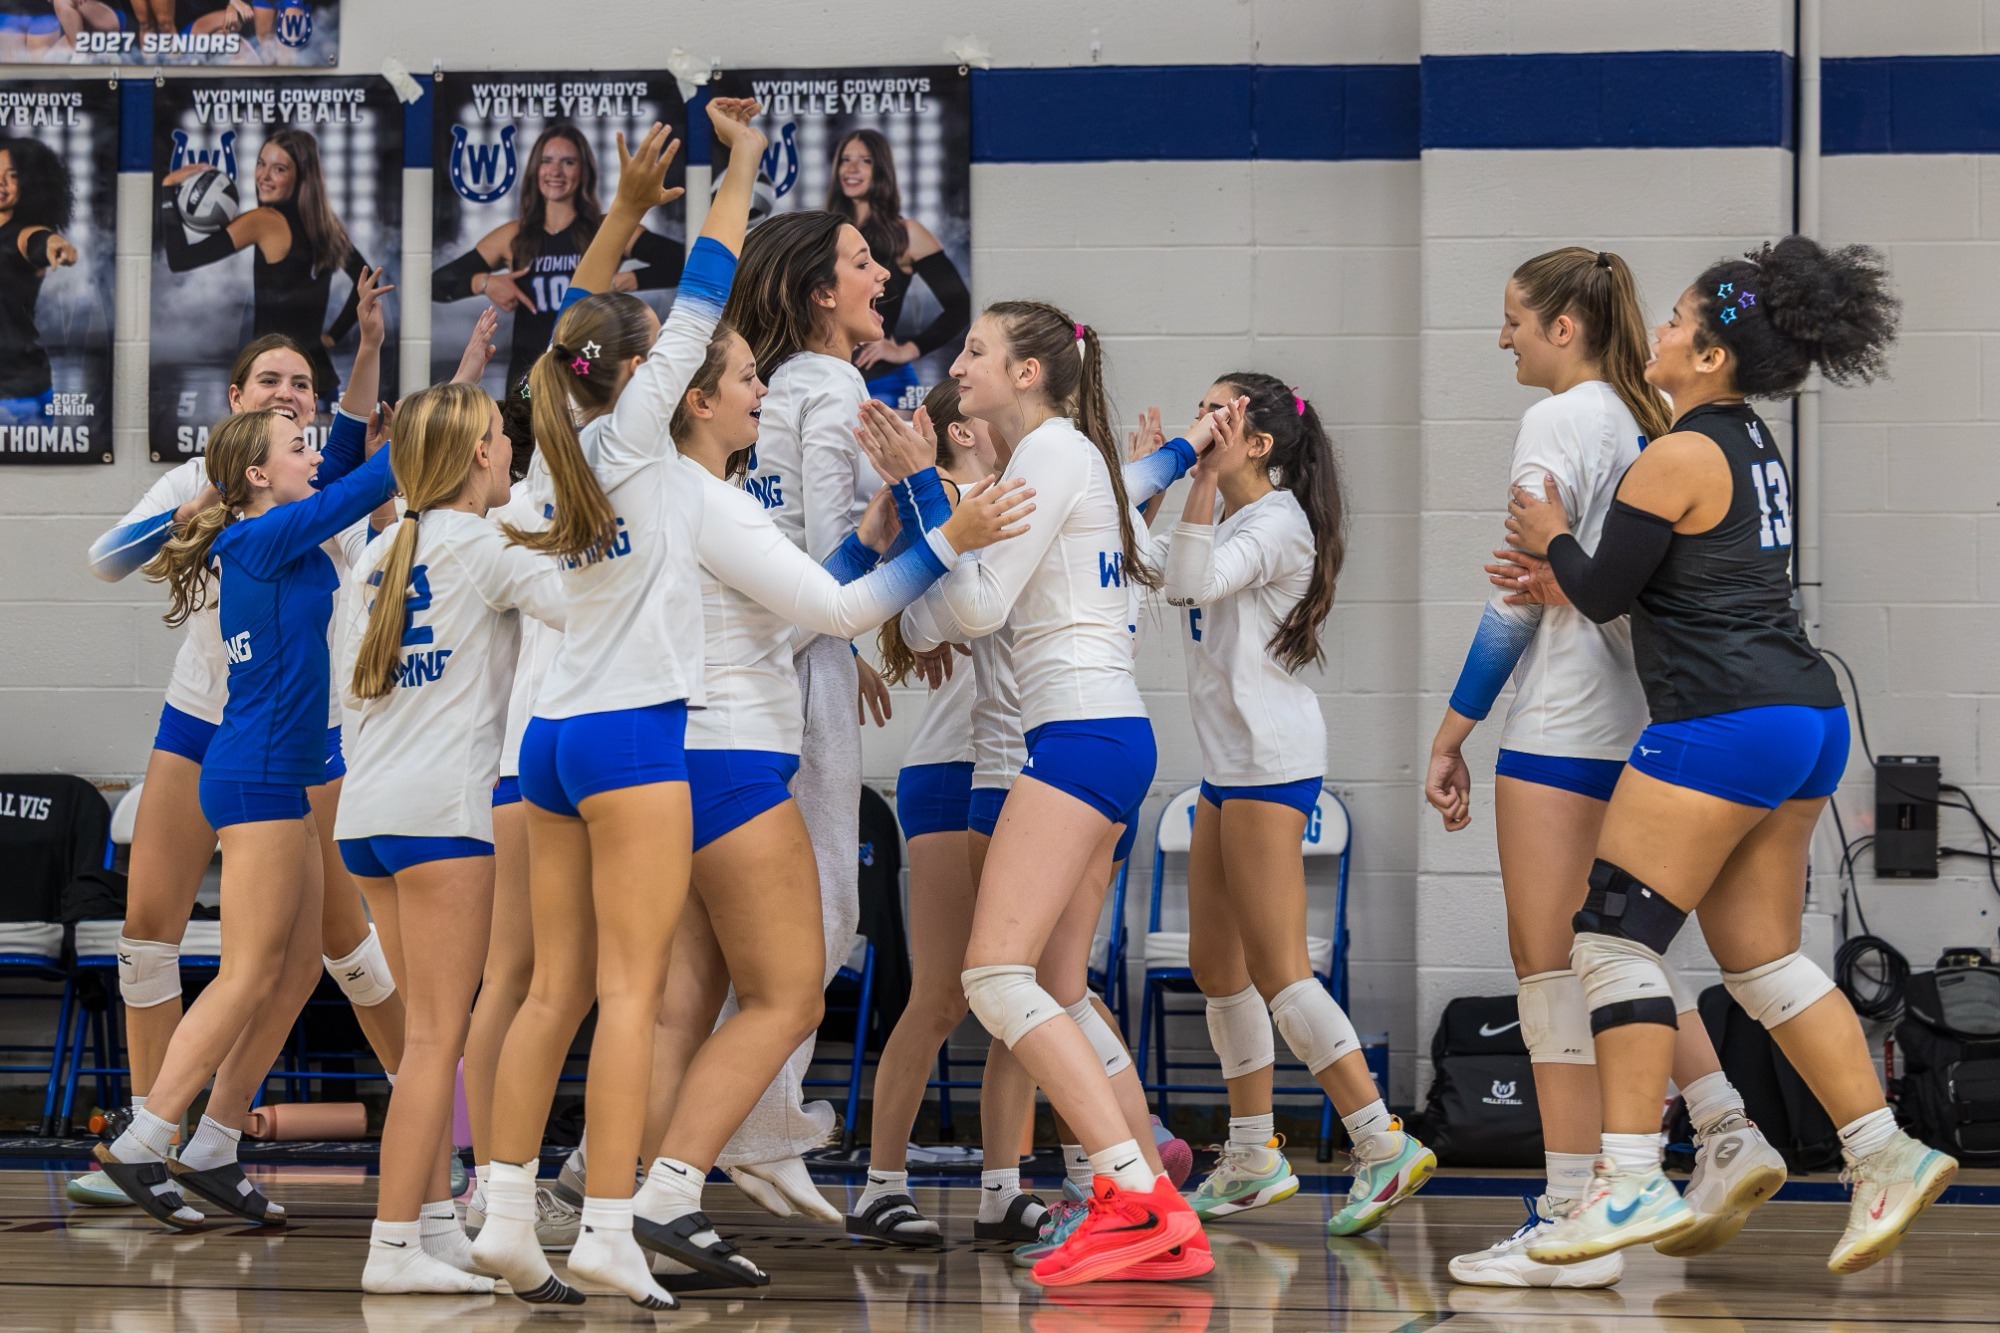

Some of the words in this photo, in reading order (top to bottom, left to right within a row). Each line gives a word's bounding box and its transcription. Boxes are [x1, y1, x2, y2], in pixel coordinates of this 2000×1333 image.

[76, 32, 136, 54] 2027
[143, 33, 241, 54] SENIORS
[192, 89, 276, 104] WYOMING
[280, 88, 366, 103] COWBOYS
[472, 82, 557, 98] WYOMING
[561, 82, 648, 97] COWBOYS
[752, 80, 838, 95] WYOMING
[843, 78, 931, 93] COWBOYS
[0, 92, 83, 107] COWBOYS
[475, 97, 646, 118] VOLLEYBALL
[755, 92, 930, 115] VOLLEYBALL
[195, 102, 364, 124] VOLLEYBALL
[467, 144, 500, 185] W
[532, 275, 571, 312] 10
[45, 404, 95, 416] SENIOR
[53, 393, 88, 405] 2027
[177, 391, 198, 417] 5
[0, 426, 90, 453] THOMAS
[1751, 459, 1792, 549] 13
[0, 792, 52, 820] LVIS
